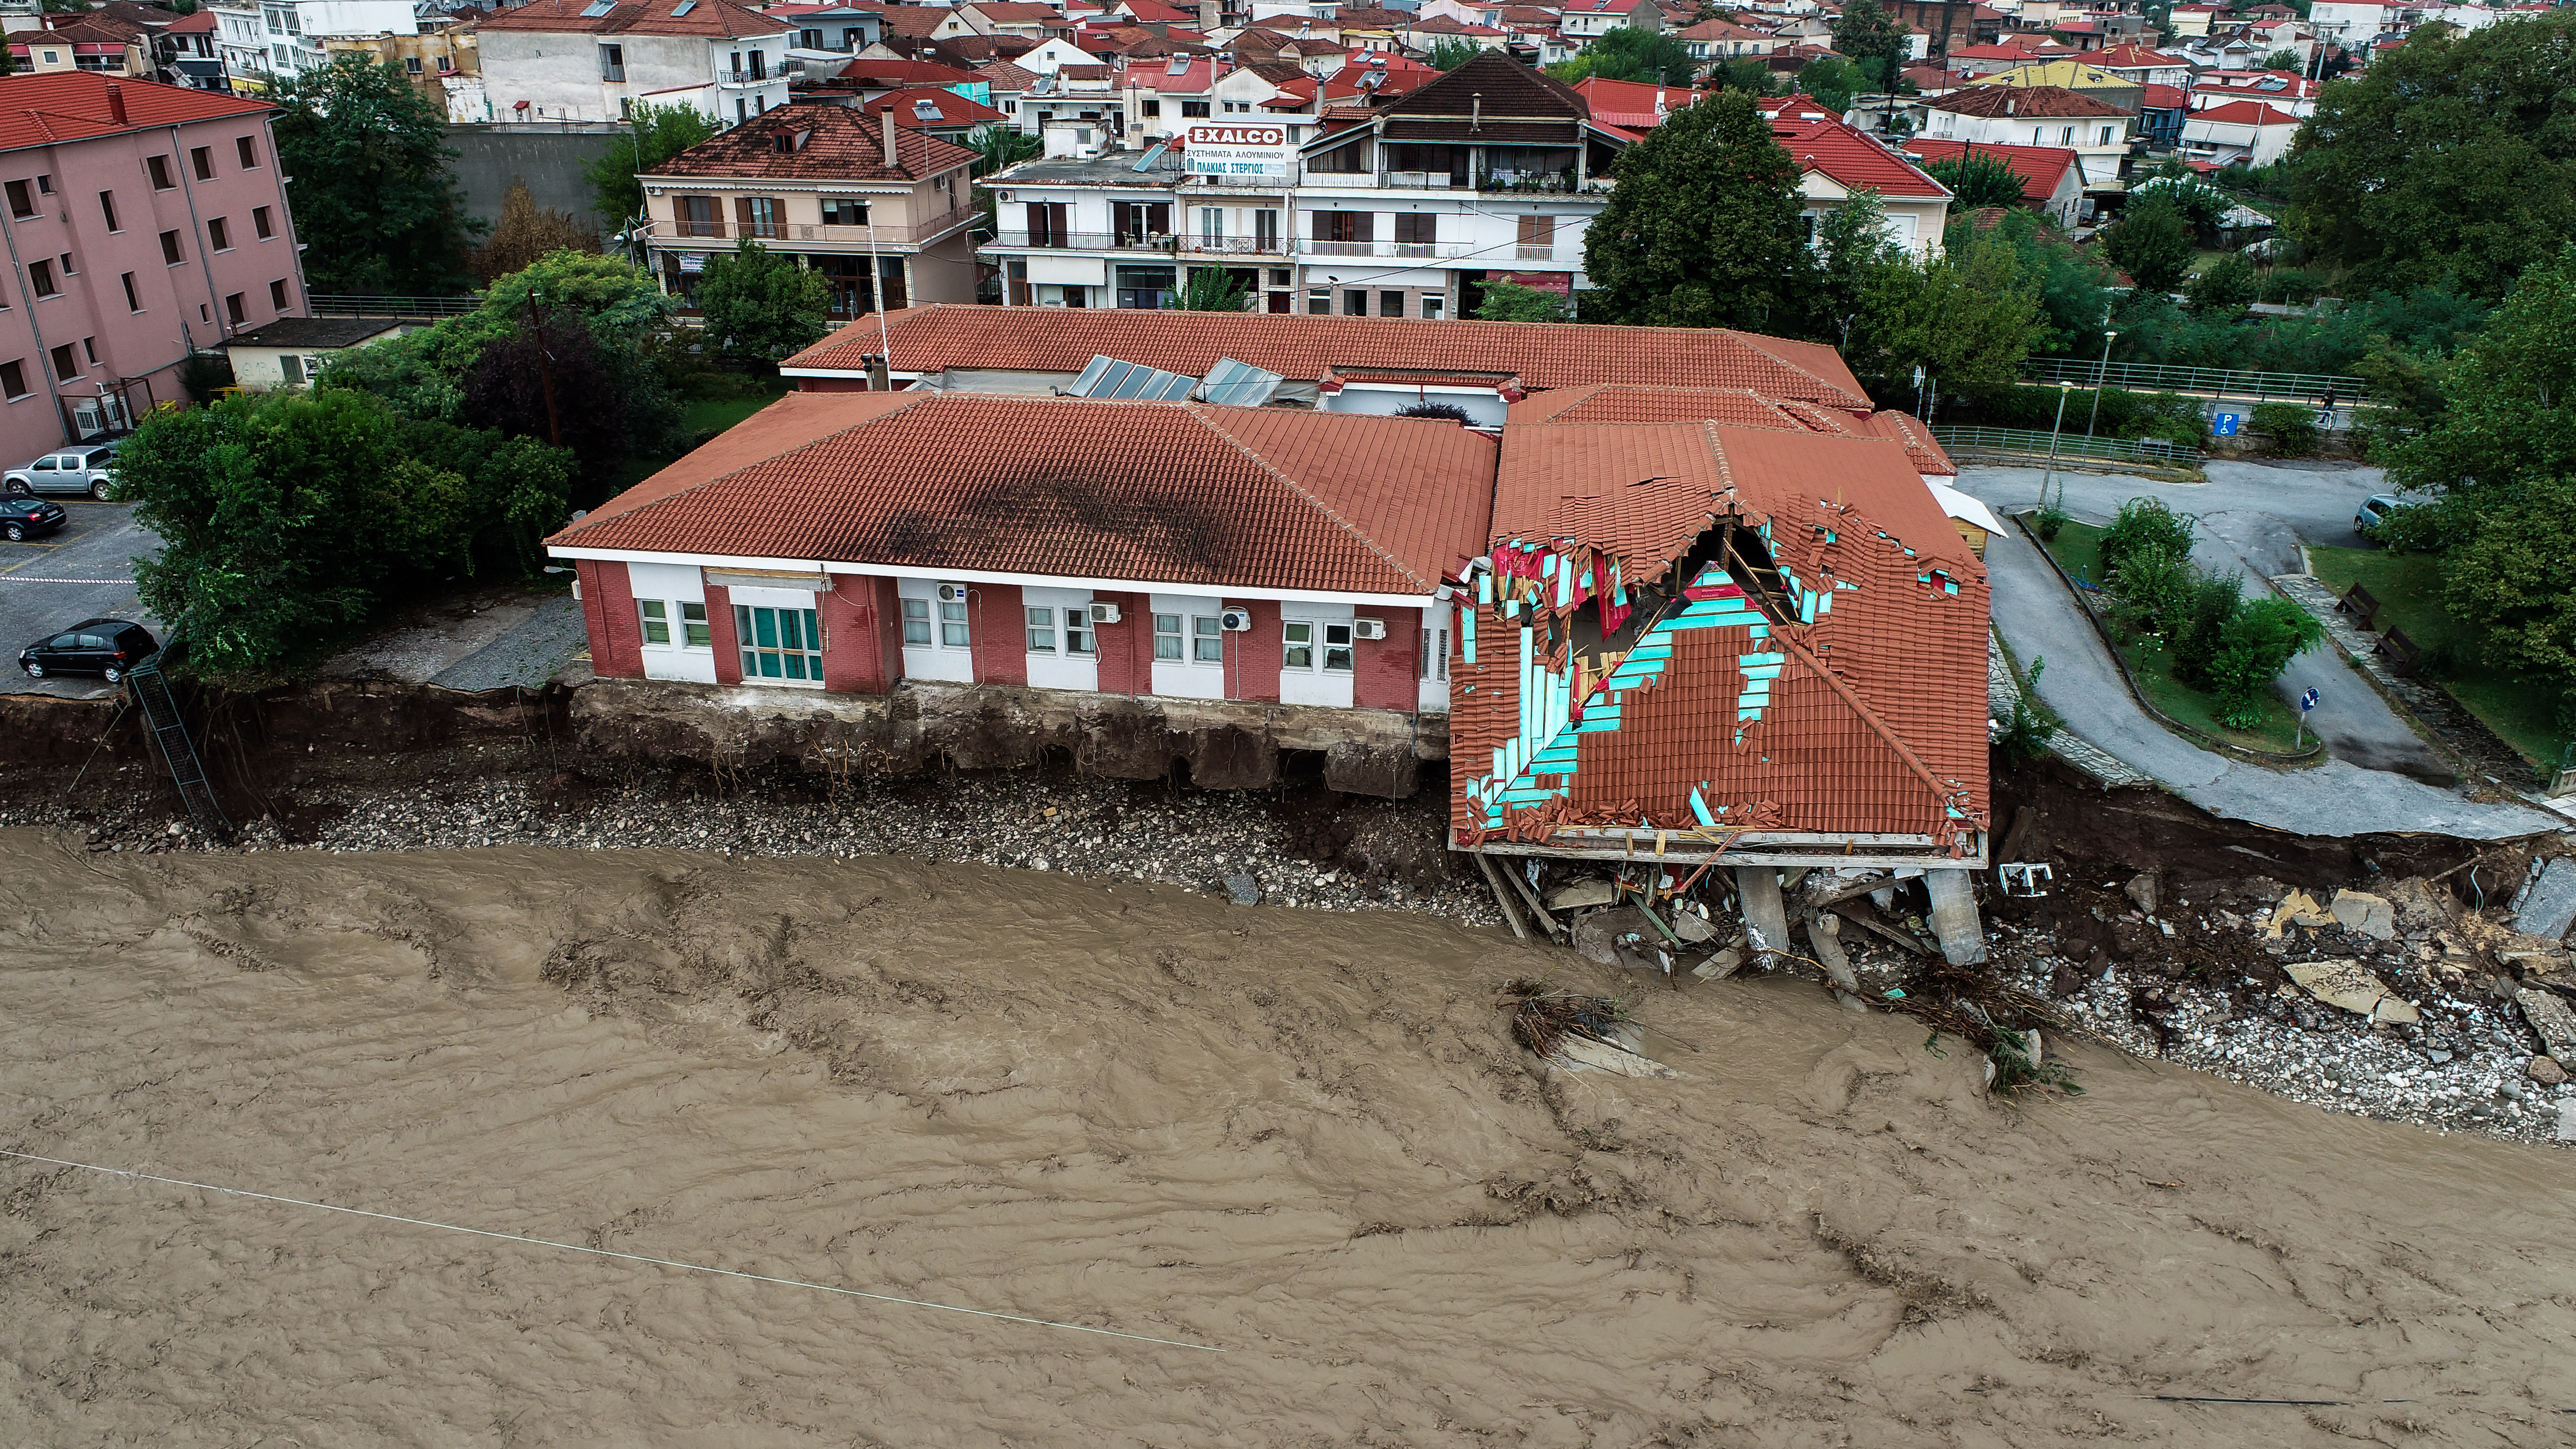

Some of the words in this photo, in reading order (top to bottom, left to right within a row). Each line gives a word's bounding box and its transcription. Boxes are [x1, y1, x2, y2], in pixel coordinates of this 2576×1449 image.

[1194, 129, 1278, 144] EXALCO
[1236, 151, 1284, 159] ΑΛΟΥΜΙΝΙΟΥ
[1197, 162, 1226, 173] ΠΛΑΚΙΑΣ
[1231, 163, 1264, 174] ΣΤΕΡΓΙΟΣ
[2223, 415, 2232, 424] P
